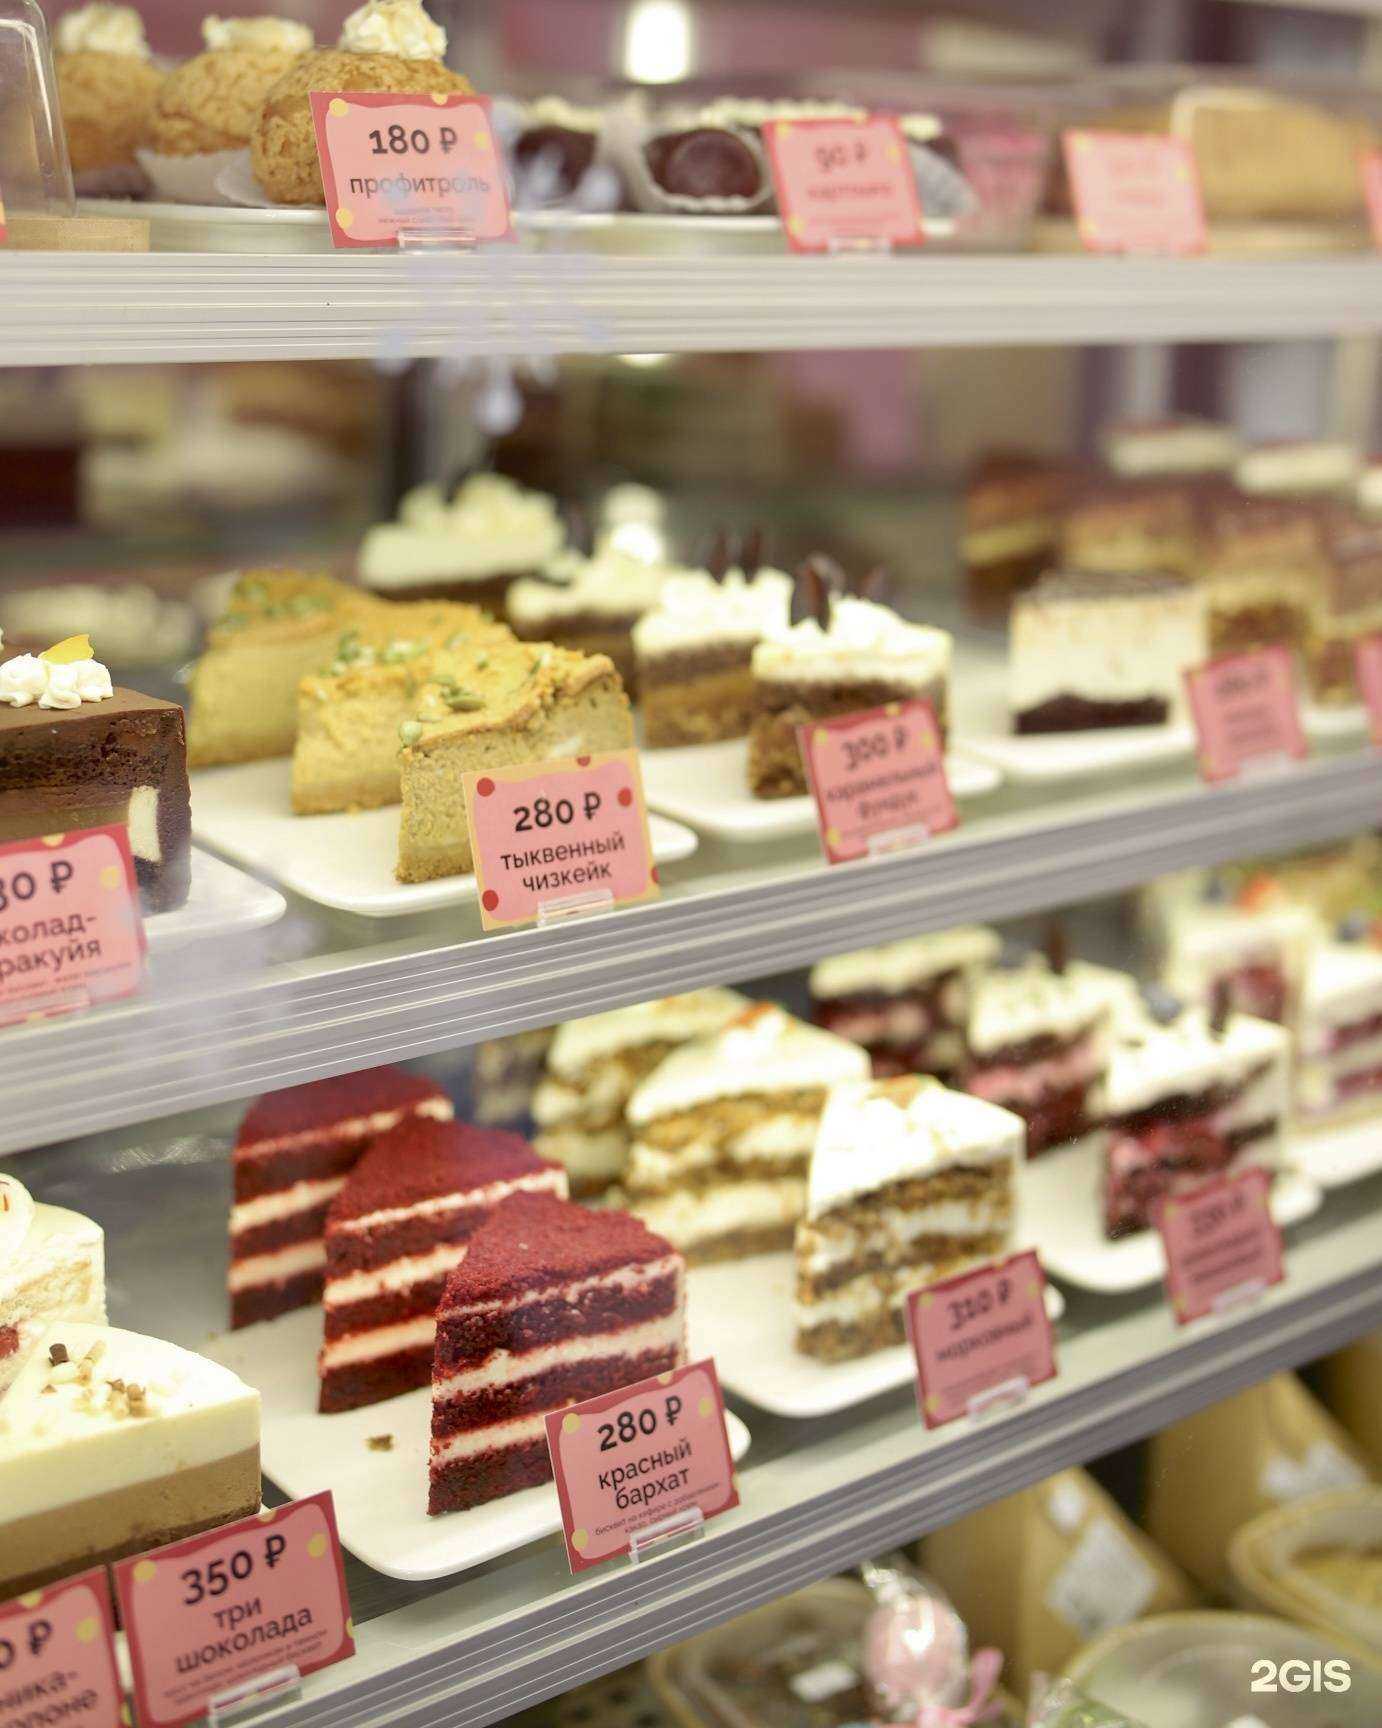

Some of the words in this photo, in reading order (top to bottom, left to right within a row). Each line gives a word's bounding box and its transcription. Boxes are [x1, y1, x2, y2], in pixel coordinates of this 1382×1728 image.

[368, 125, 430, 154] 180
[439, 126, 458, 154] ₽
[350, 172, 491, 199] профитроль
[513, 796, 574, 832] 280
[583, 791, 602, 820] ₽
[500, 831, 626, 870] тыквенный
[50, 859, 74, 894] ₽
[522, 861, 613, 892] чизкейк
[597, 1408, 657, 1452] 280
[666, 1395, 683, 1426] ₽
[598, 1437, 693, 1490] красный
[616, 1467, 690, 1510] бархат
[180, 1550, 253, 1606] 350
[265, 1534, 287, 1569] ₽
[213, 1597, 263, 1631] три
[175, 1607, 313, 1673] шоколада
